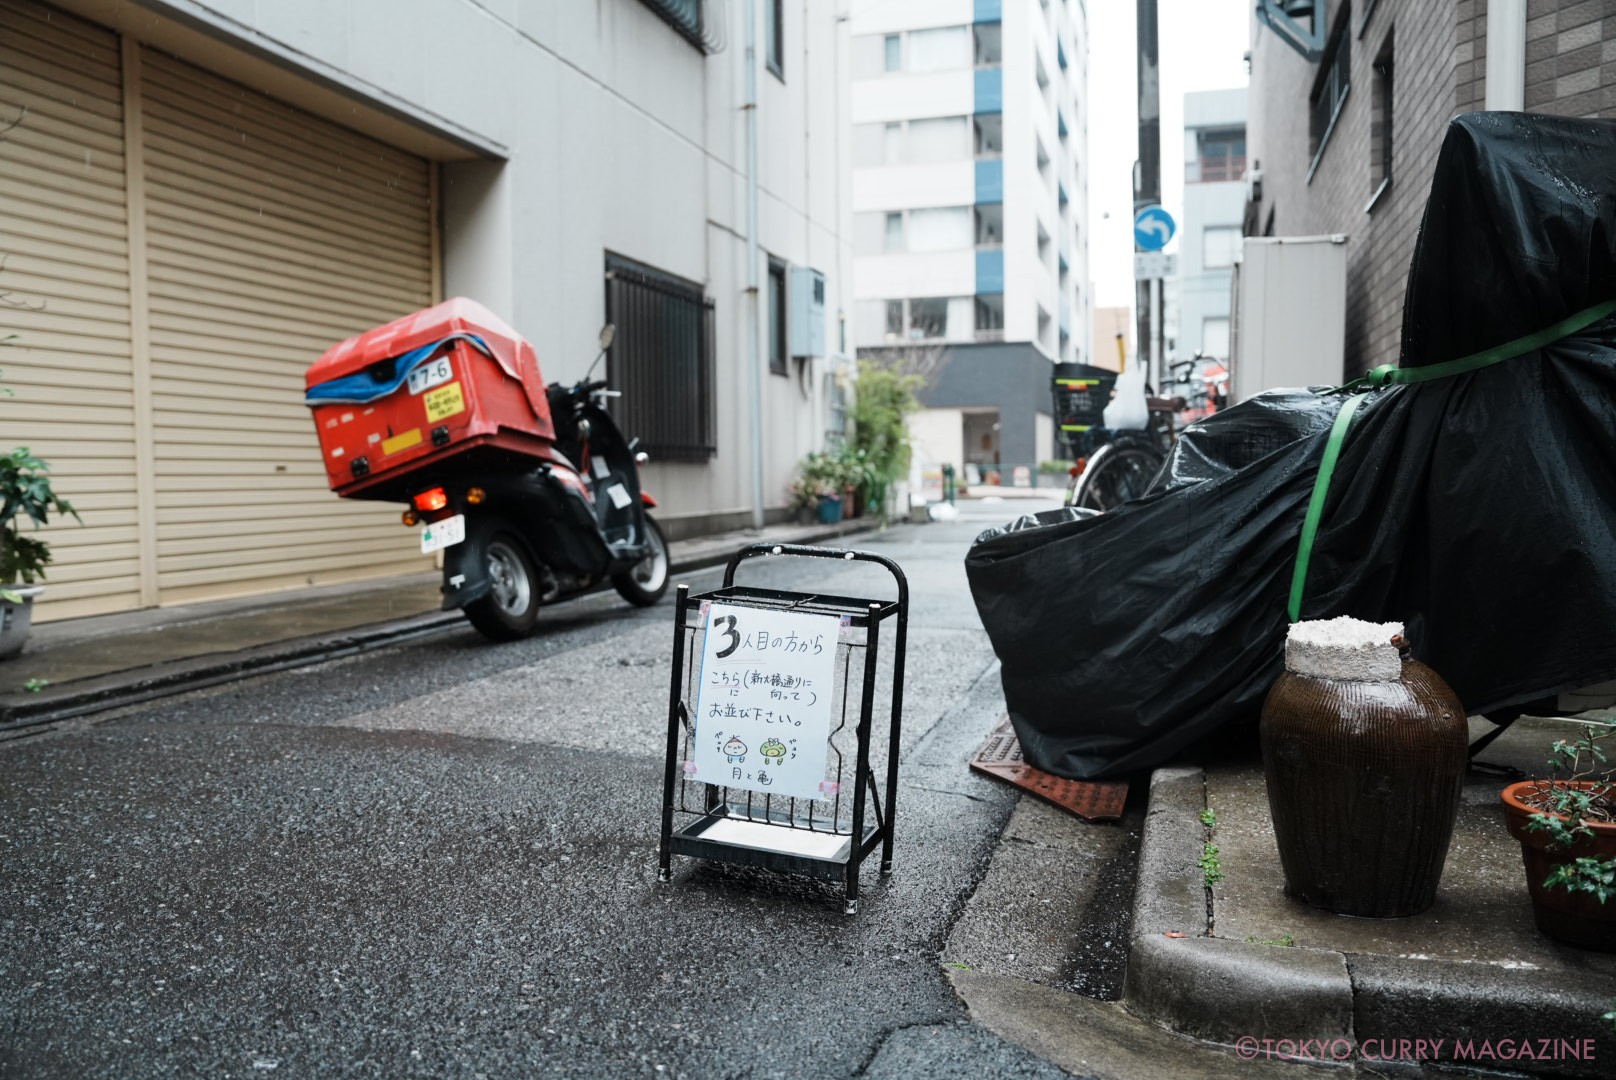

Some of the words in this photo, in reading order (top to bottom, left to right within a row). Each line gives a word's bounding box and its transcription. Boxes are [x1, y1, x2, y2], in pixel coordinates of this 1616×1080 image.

[420, 361, 447, 385] 7-6
[713, 614, 824, 659] 3人目の方から
[709, 702, 802, 727] お並び下さい。
[732, 767, 773, 786] 月と亀
